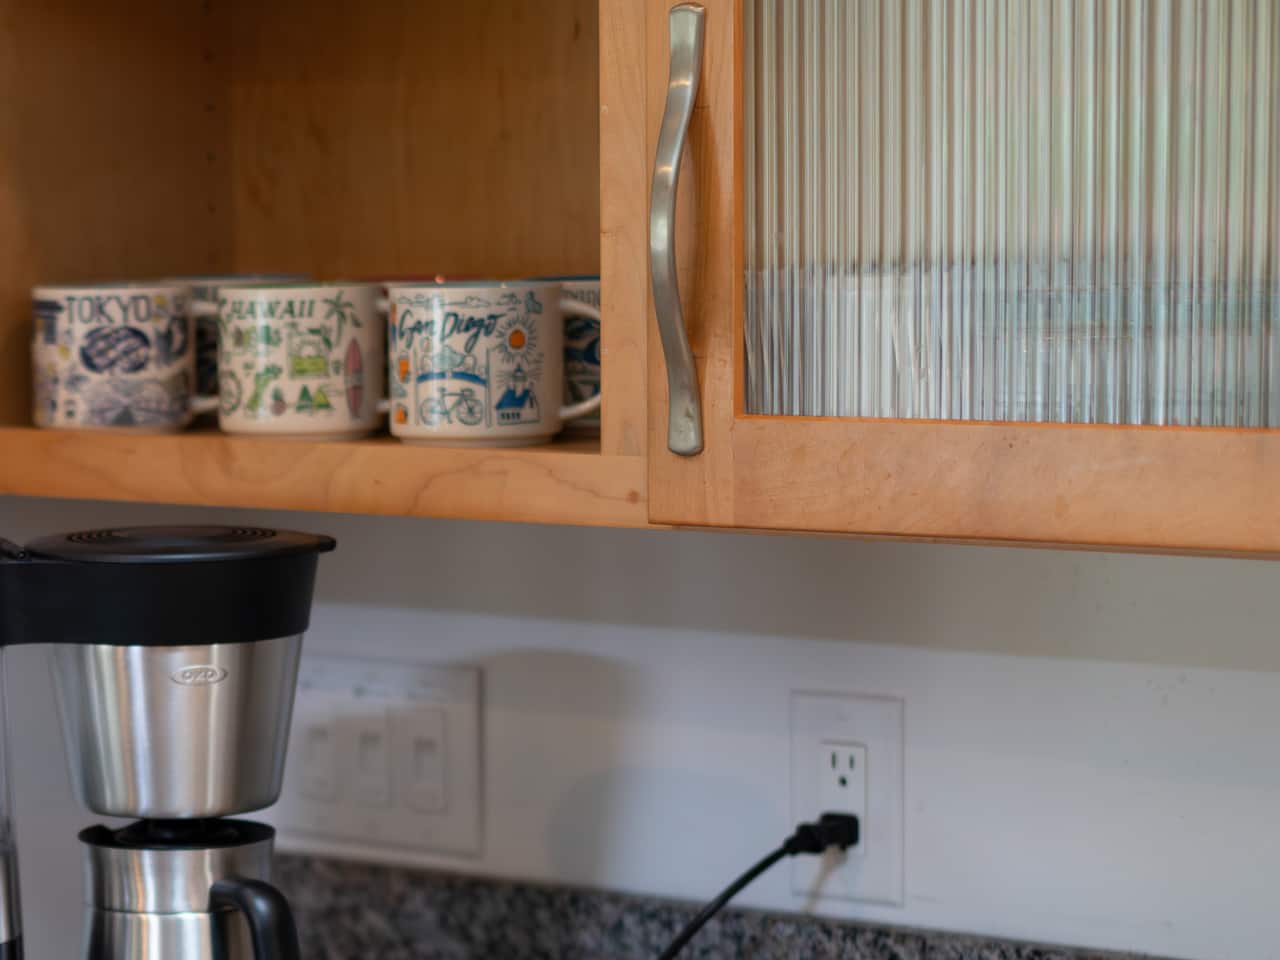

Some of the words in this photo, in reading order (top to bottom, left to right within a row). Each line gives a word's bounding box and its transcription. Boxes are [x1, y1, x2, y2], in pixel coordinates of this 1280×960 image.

[65, 294, 152, 324] TOKYO
[228, 298, 316, 320] HAWAII
[440, 311, 507, 353] Diego
